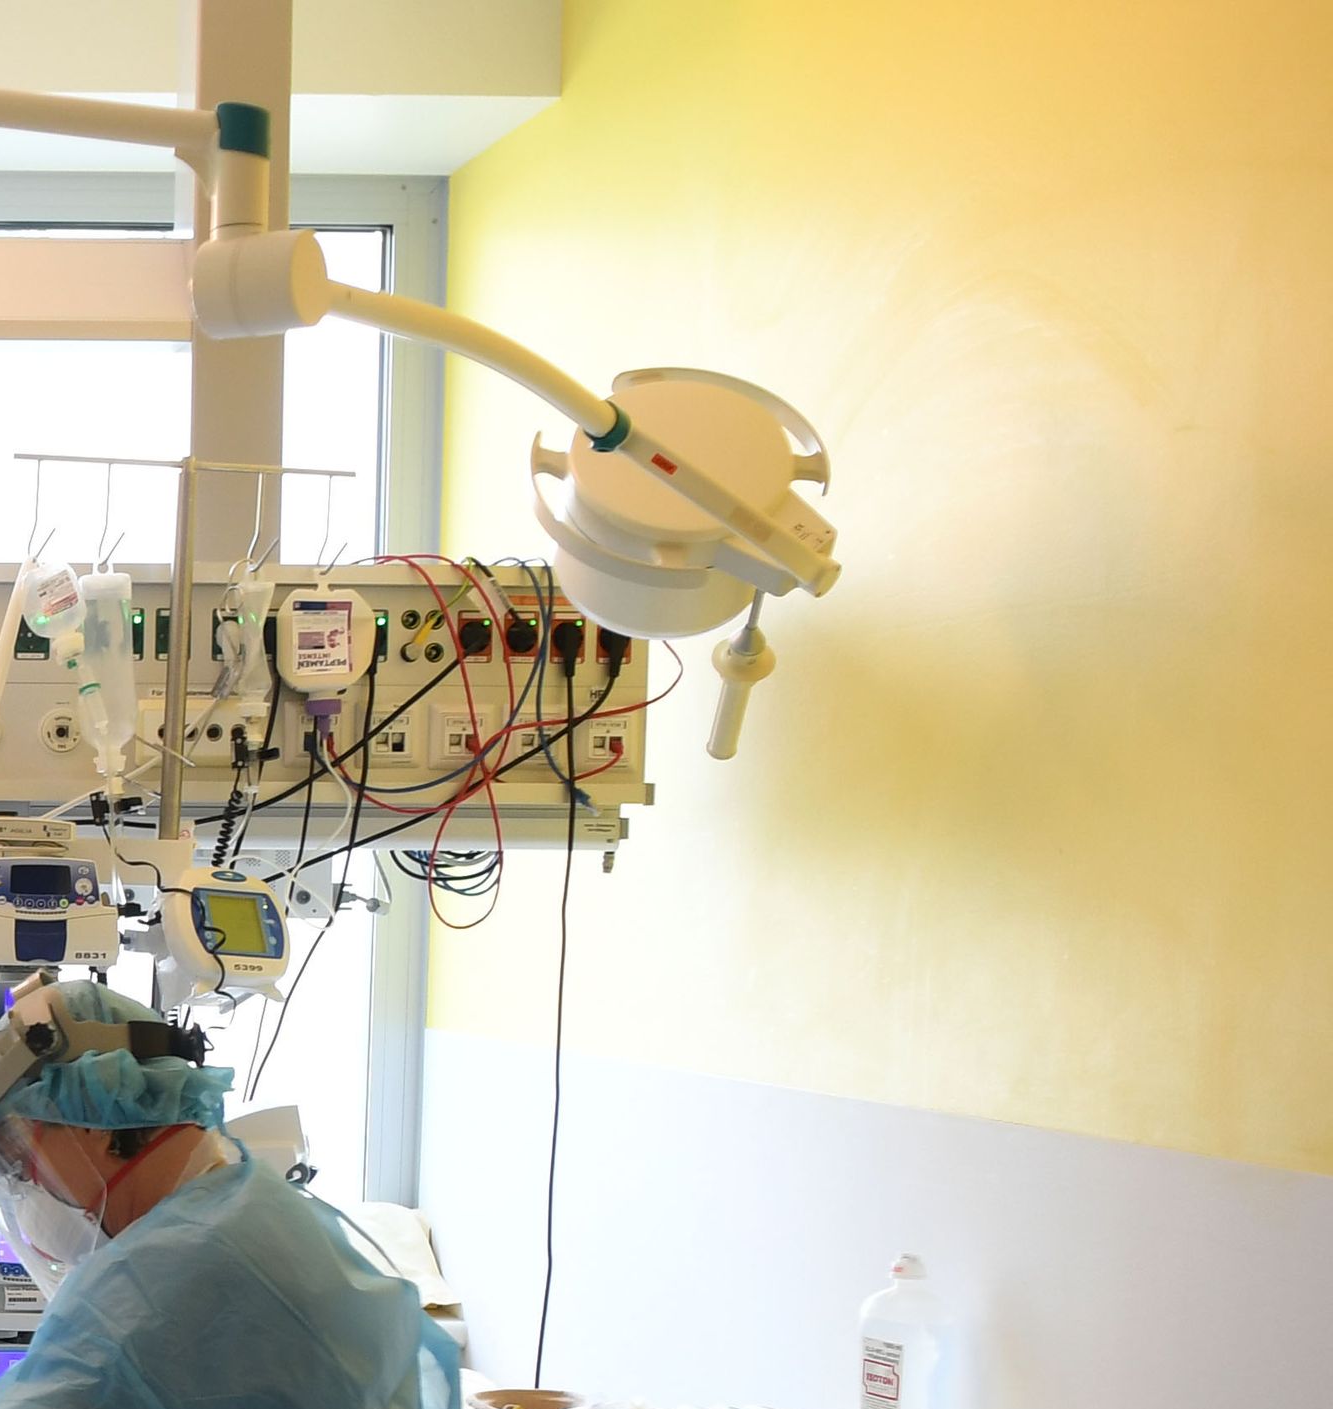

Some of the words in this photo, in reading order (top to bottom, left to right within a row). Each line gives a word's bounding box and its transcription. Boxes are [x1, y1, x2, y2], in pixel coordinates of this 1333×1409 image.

[297, 658, 347, 670] PEPTAMEN
[75, 952, 107, 960] 8831
[234, 964, 264, 972] 5399
